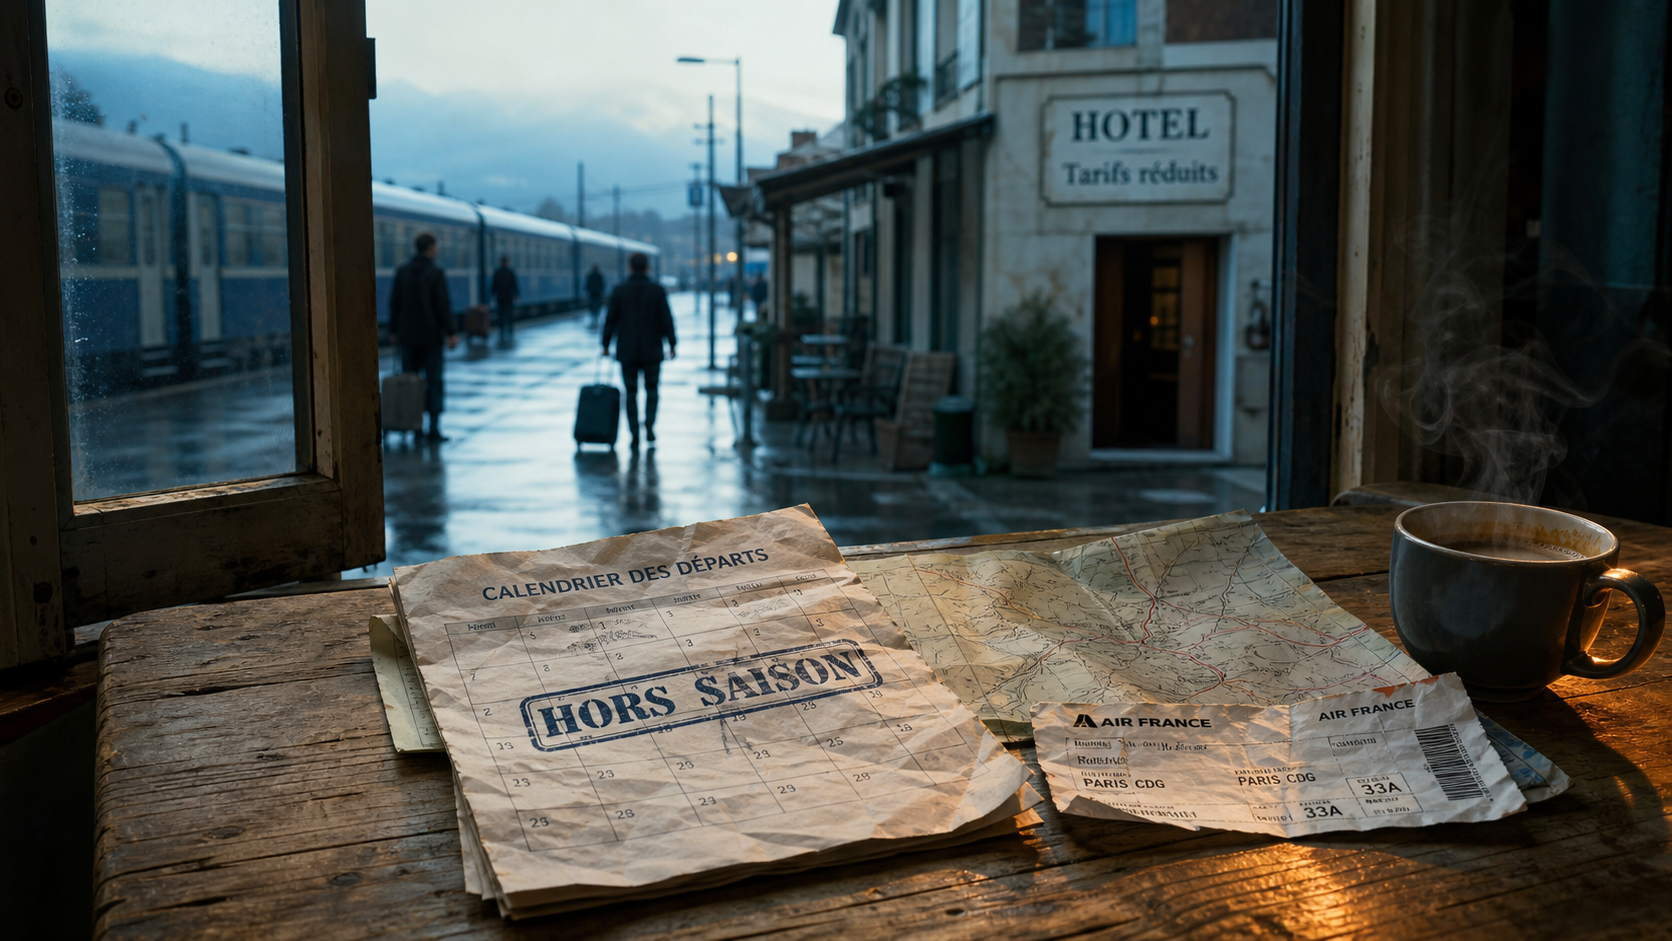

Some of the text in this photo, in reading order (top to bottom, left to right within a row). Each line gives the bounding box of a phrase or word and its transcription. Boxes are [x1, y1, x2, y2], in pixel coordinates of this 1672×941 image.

[1071, 107, 1210, 143] HOTEL
[1062, 159, 1219, 186] Tarifs réduits
[482, 548, 769, 601] CALENDRIER DES DÉPARTS
[538, 650, 863, 738] HORS SAISON
[483, 708, 493, 716] 2
[1318, 698, 1416, 722] AIR FRANCE
[1101, 717, 1212, 728] AIR FRANCE
[1083, 778, 1166, 789] PARIS CDG
[1238, 772, 1317, 786] PARIS CDG
[1361, 781, 1403, 795] 33A
[1303, 805, 1343, 819] 33A
